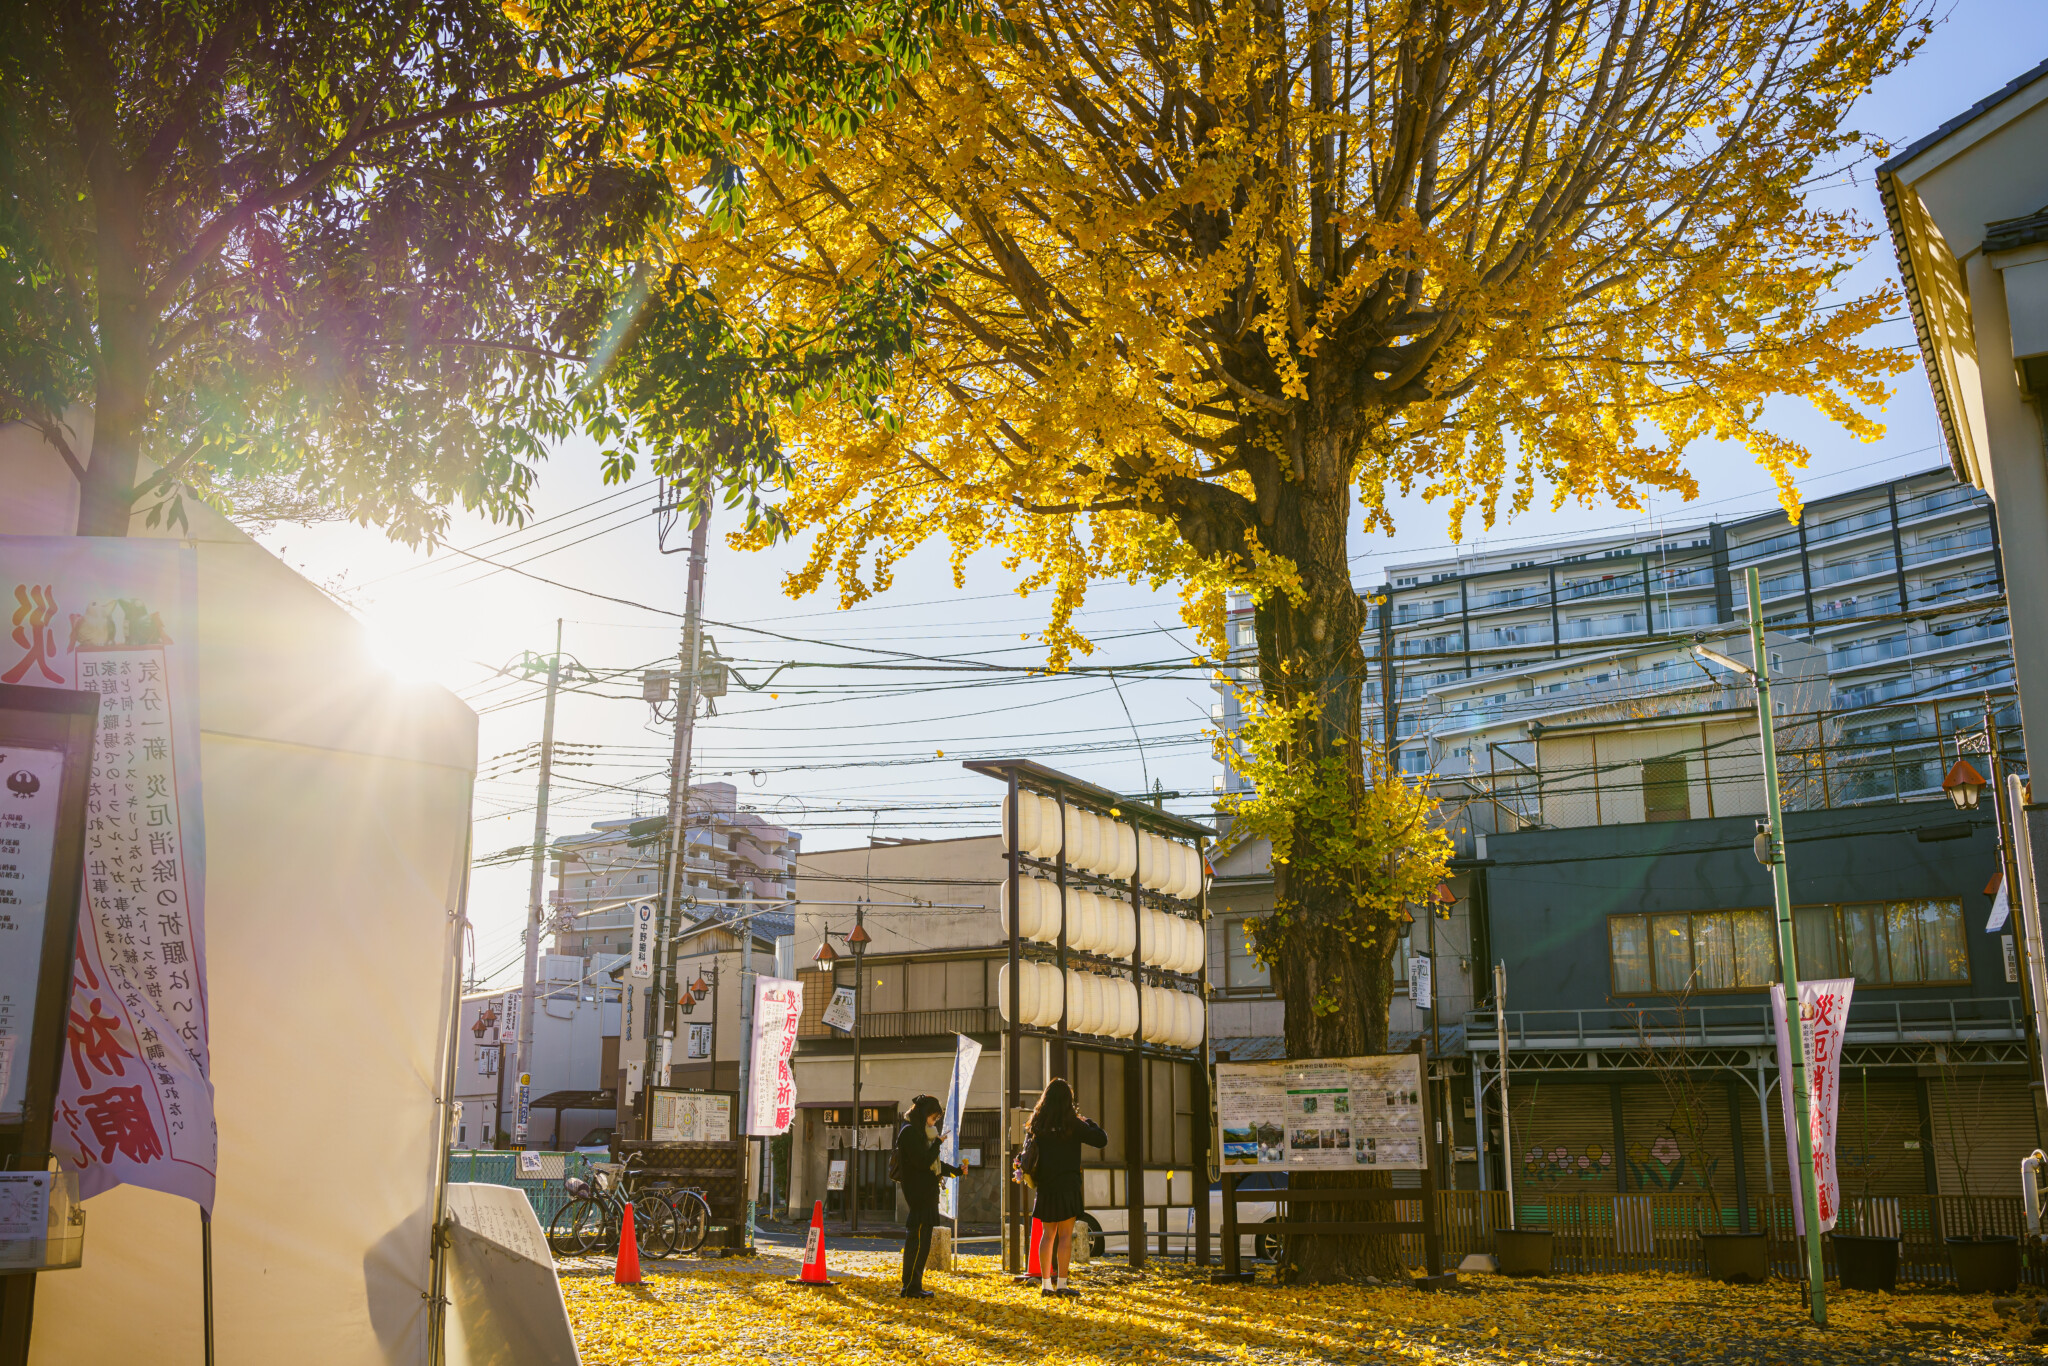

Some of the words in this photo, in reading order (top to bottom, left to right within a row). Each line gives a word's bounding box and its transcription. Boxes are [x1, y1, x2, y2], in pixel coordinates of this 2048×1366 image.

[638, 923, 648, 962] 中野歯科
[2006, 943, 2017, 980] 二丁目商店会
[775, 989, 797, 1129] 災厄消除祈願
